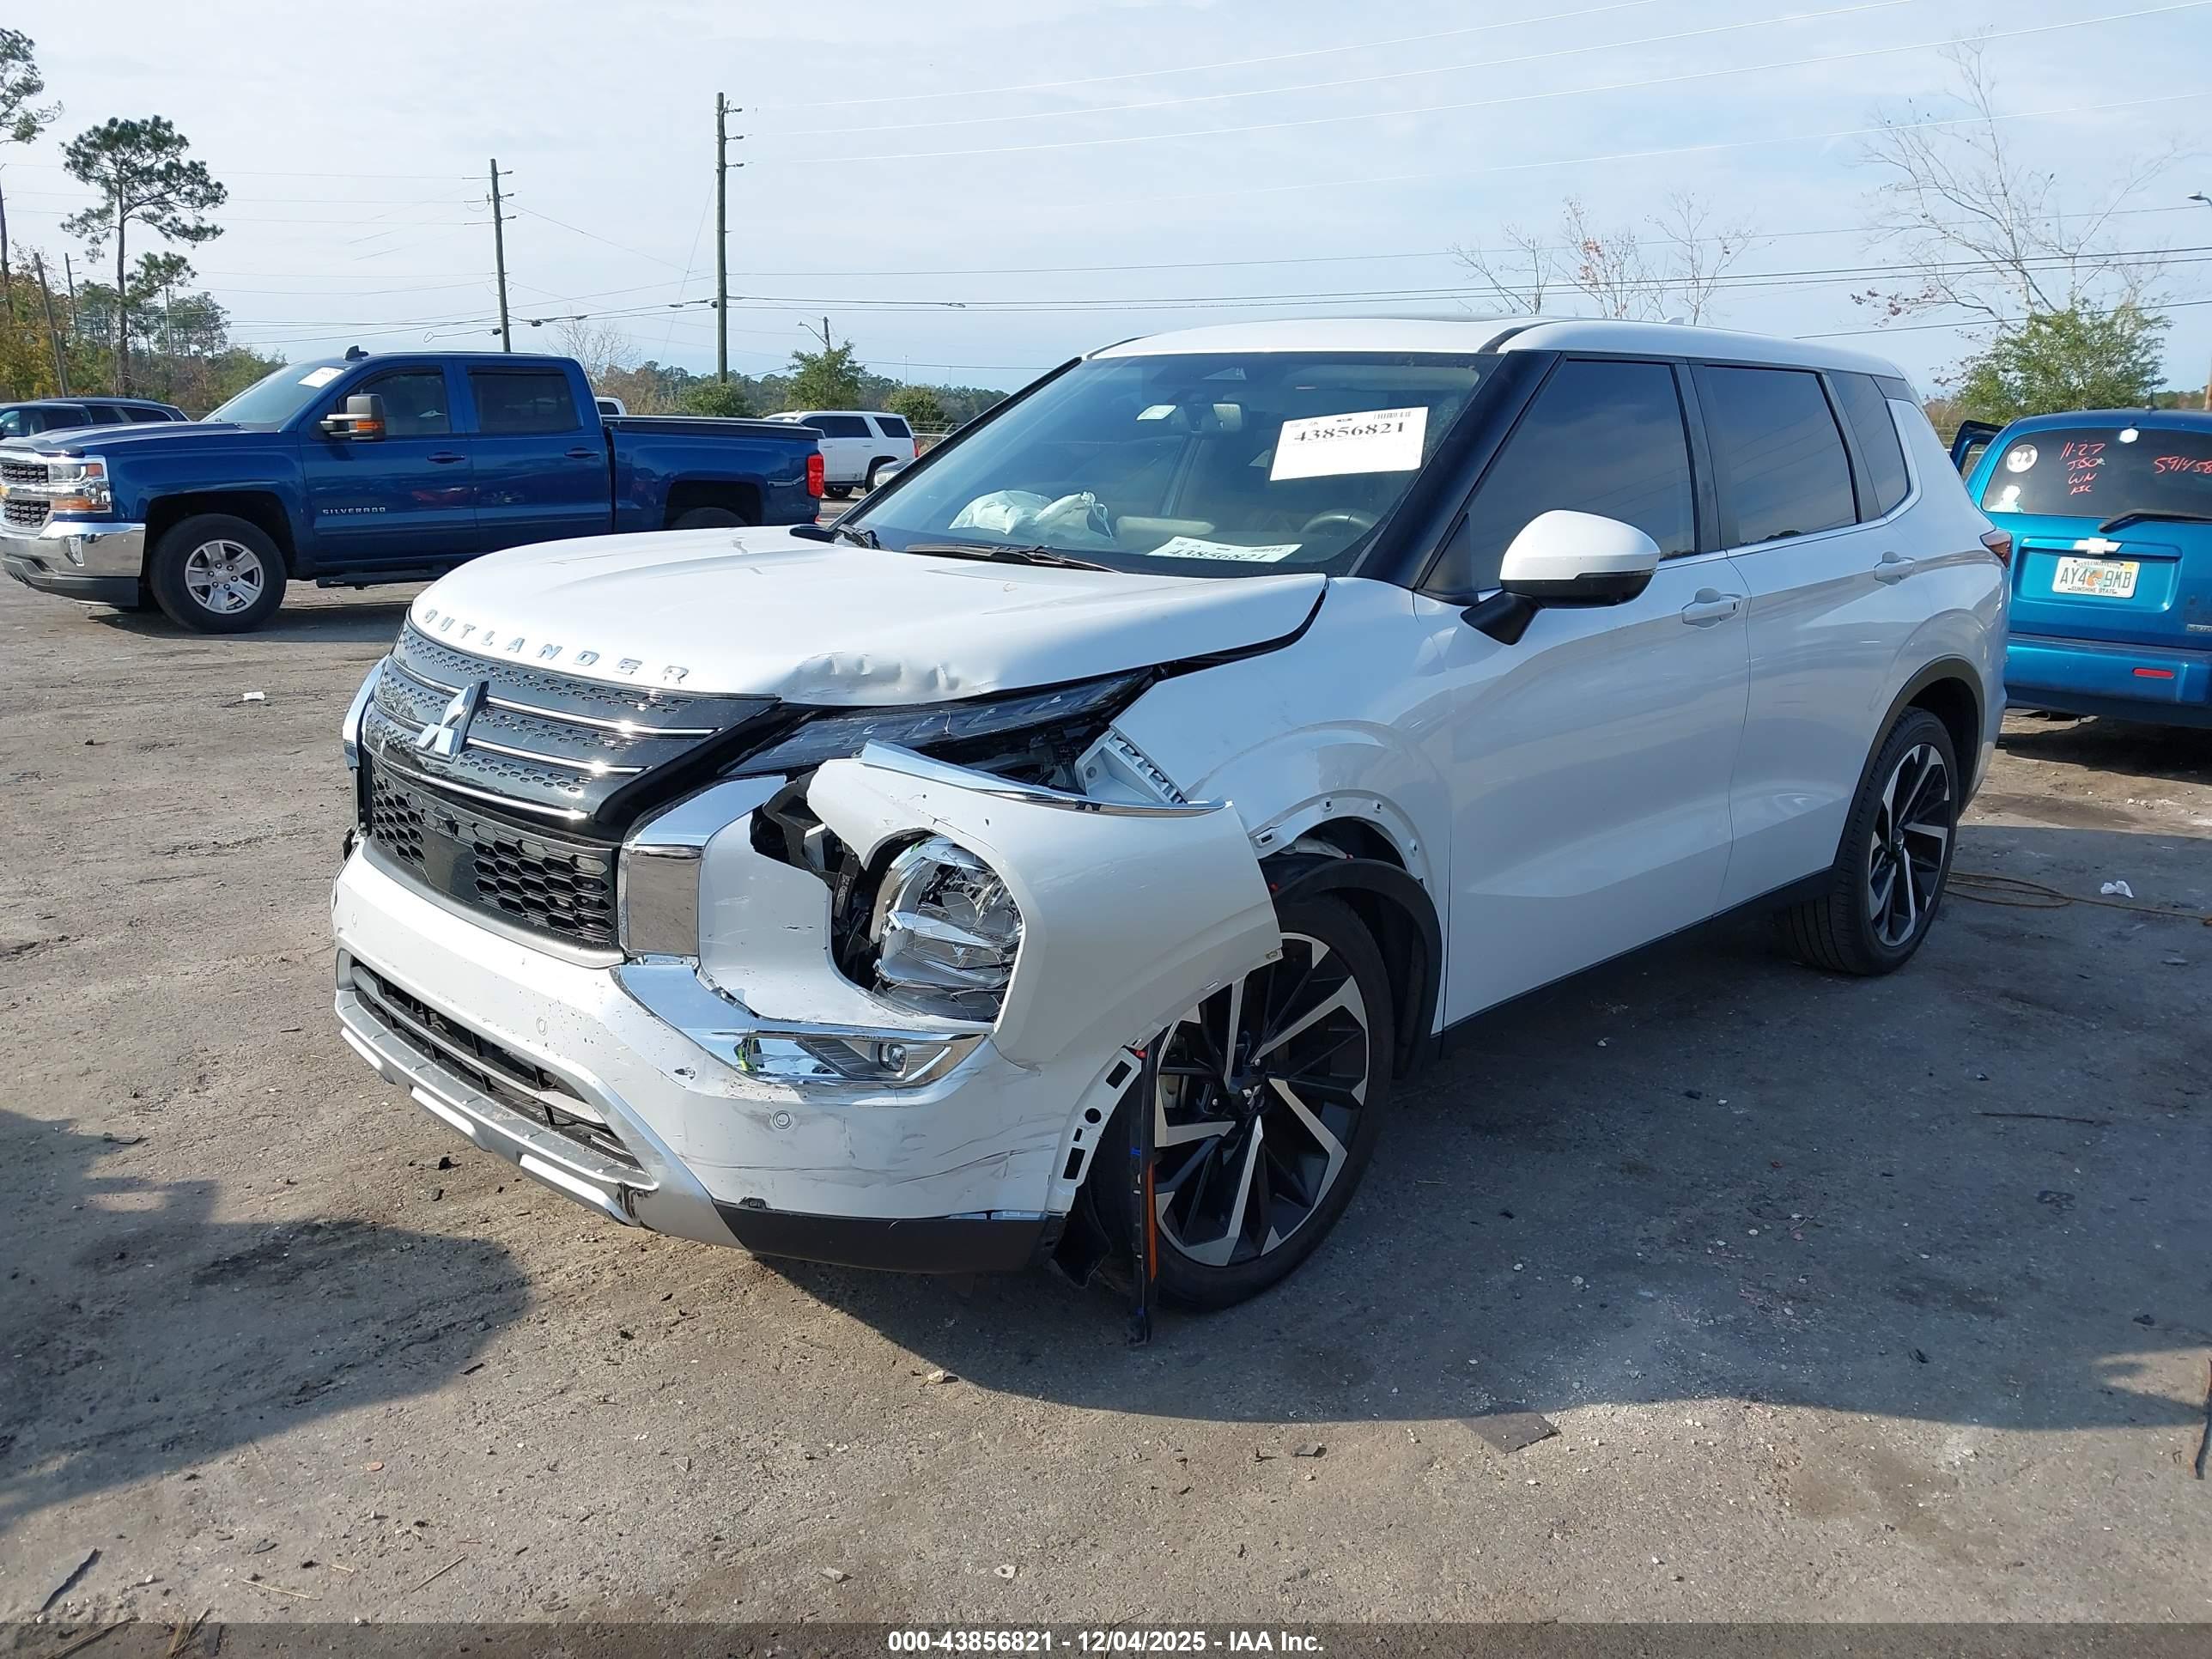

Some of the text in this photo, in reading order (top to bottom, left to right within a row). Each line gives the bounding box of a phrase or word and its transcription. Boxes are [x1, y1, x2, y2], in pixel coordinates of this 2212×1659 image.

[1294, 421, 1404, 441] 43856821
[2059, 441, 2106, 460] 11-27
[322, 507, 386, 515] SILVERADO
[2060, 567, 2088, 585] AY4
[424, 608, 690, 684] OUTLANDER
